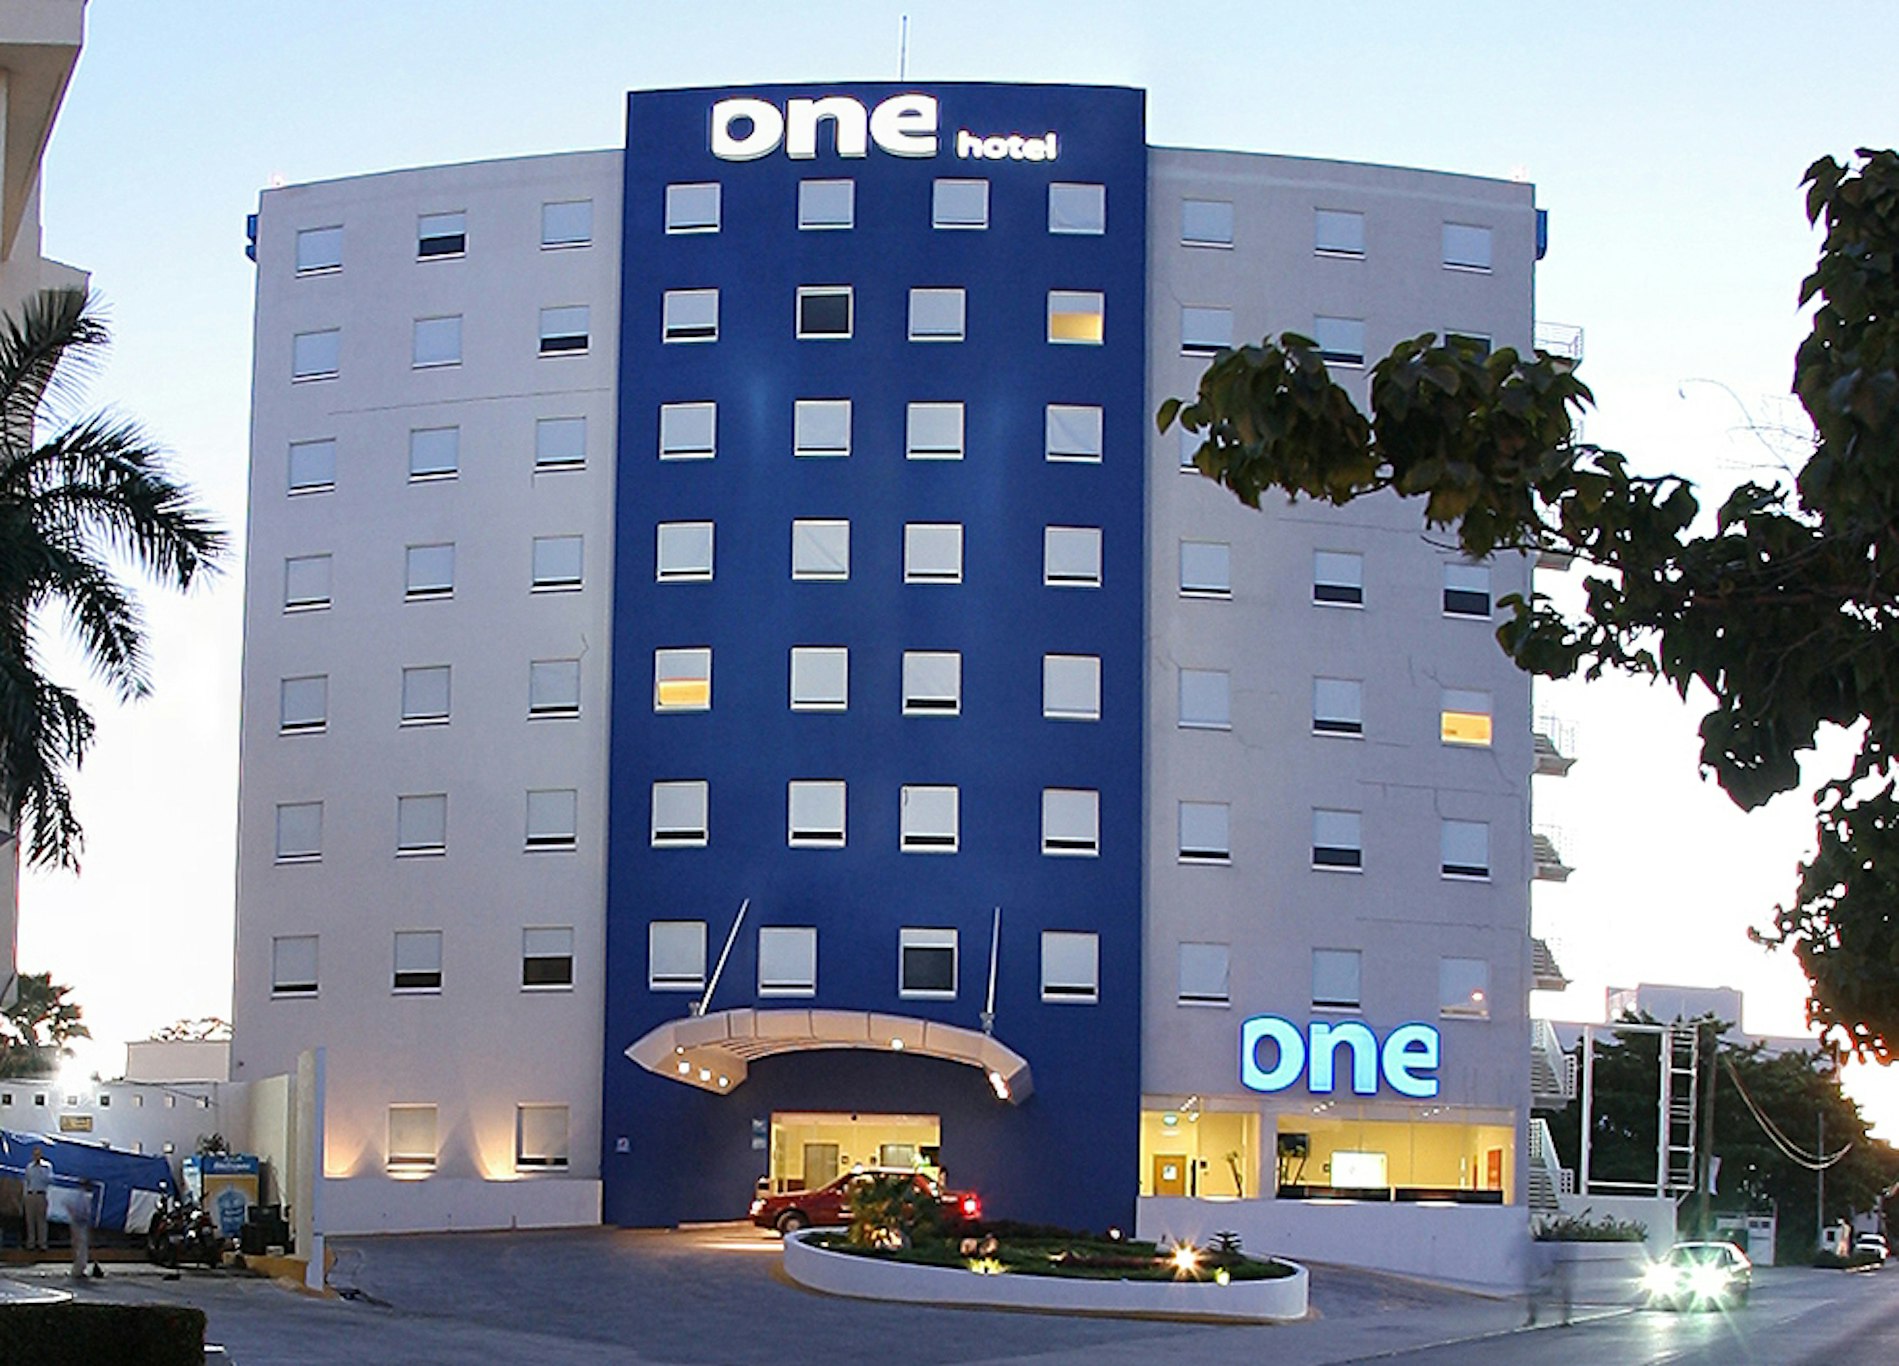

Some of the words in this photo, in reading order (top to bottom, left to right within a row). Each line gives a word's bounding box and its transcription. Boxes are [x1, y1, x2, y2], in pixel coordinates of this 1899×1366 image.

[710, 94, 939, 161] one
[956, 130, 1058, 161] hotel
[1241, 1014, 1441, 1098] one
